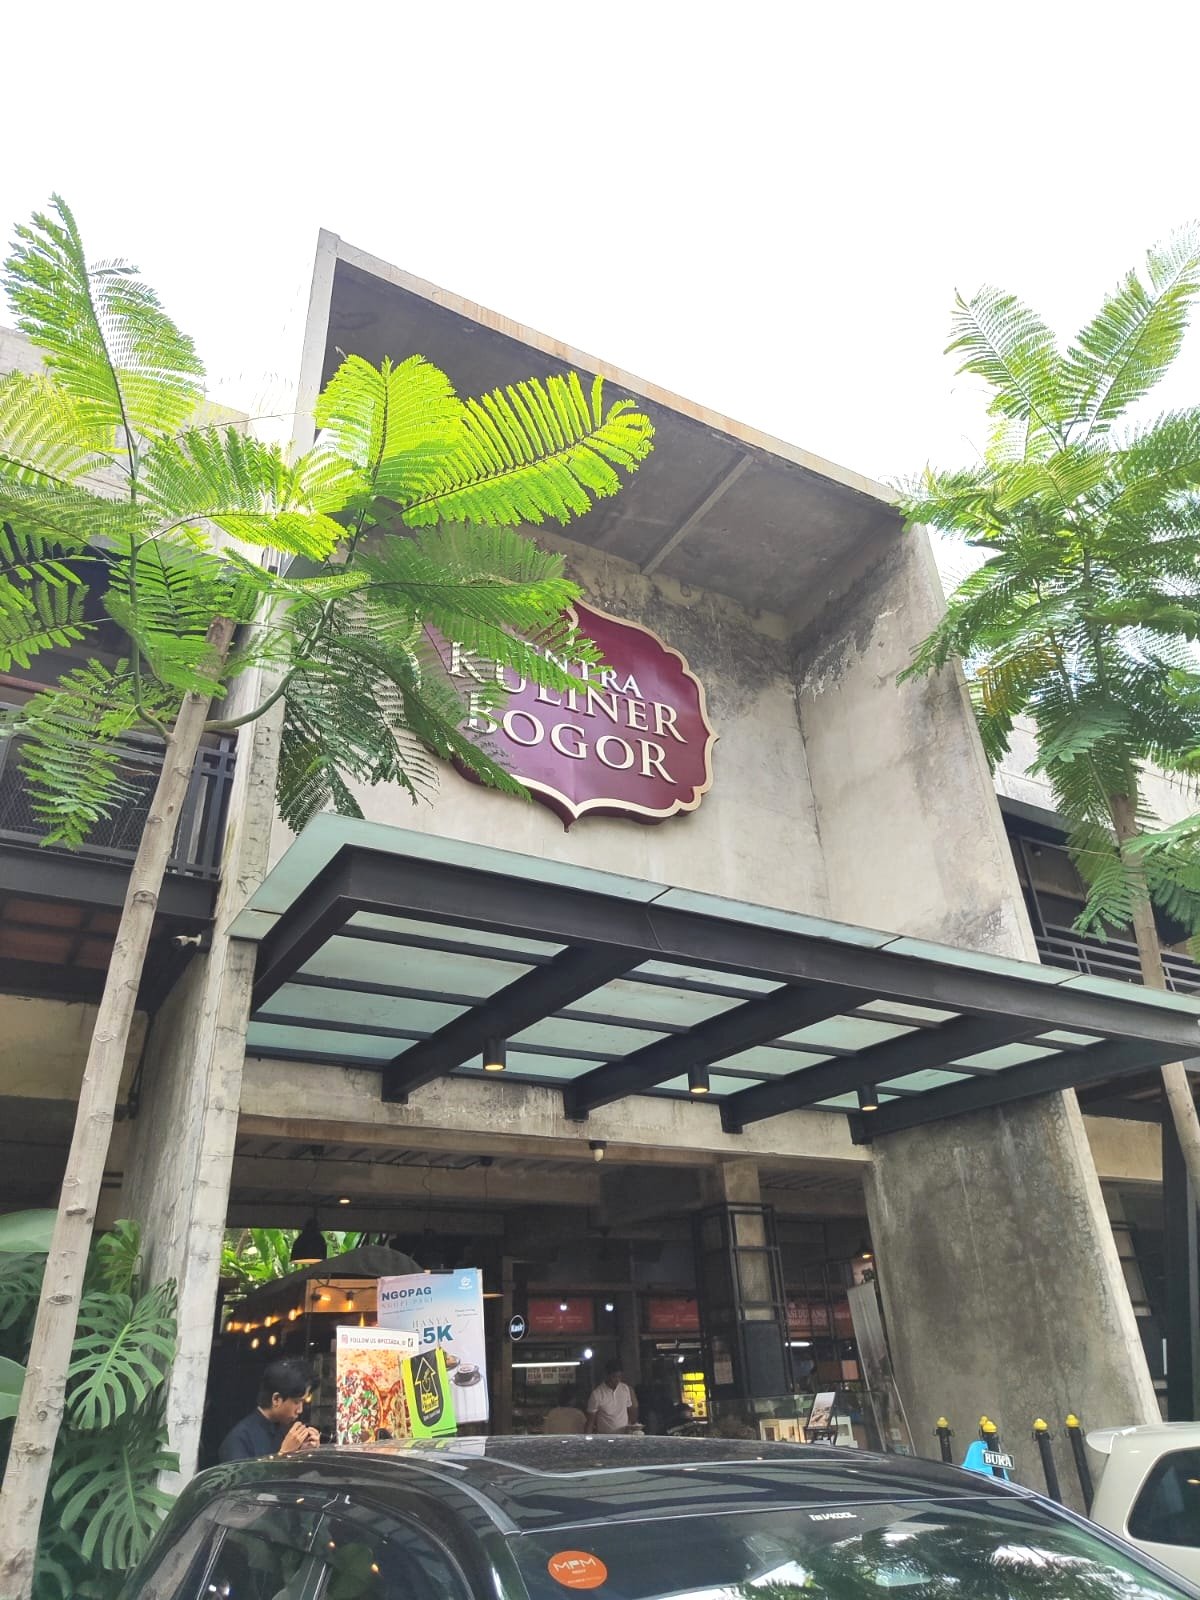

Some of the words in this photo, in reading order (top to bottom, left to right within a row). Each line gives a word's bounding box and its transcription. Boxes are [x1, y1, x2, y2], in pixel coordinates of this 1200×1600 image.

[449, 641, 688, 744] KULINER
[464, 690, 678, 785] BOGOR
[381, 1286, 432, 1302] NGOPAG
[984, 1452, 1013, 1467] BUKA
